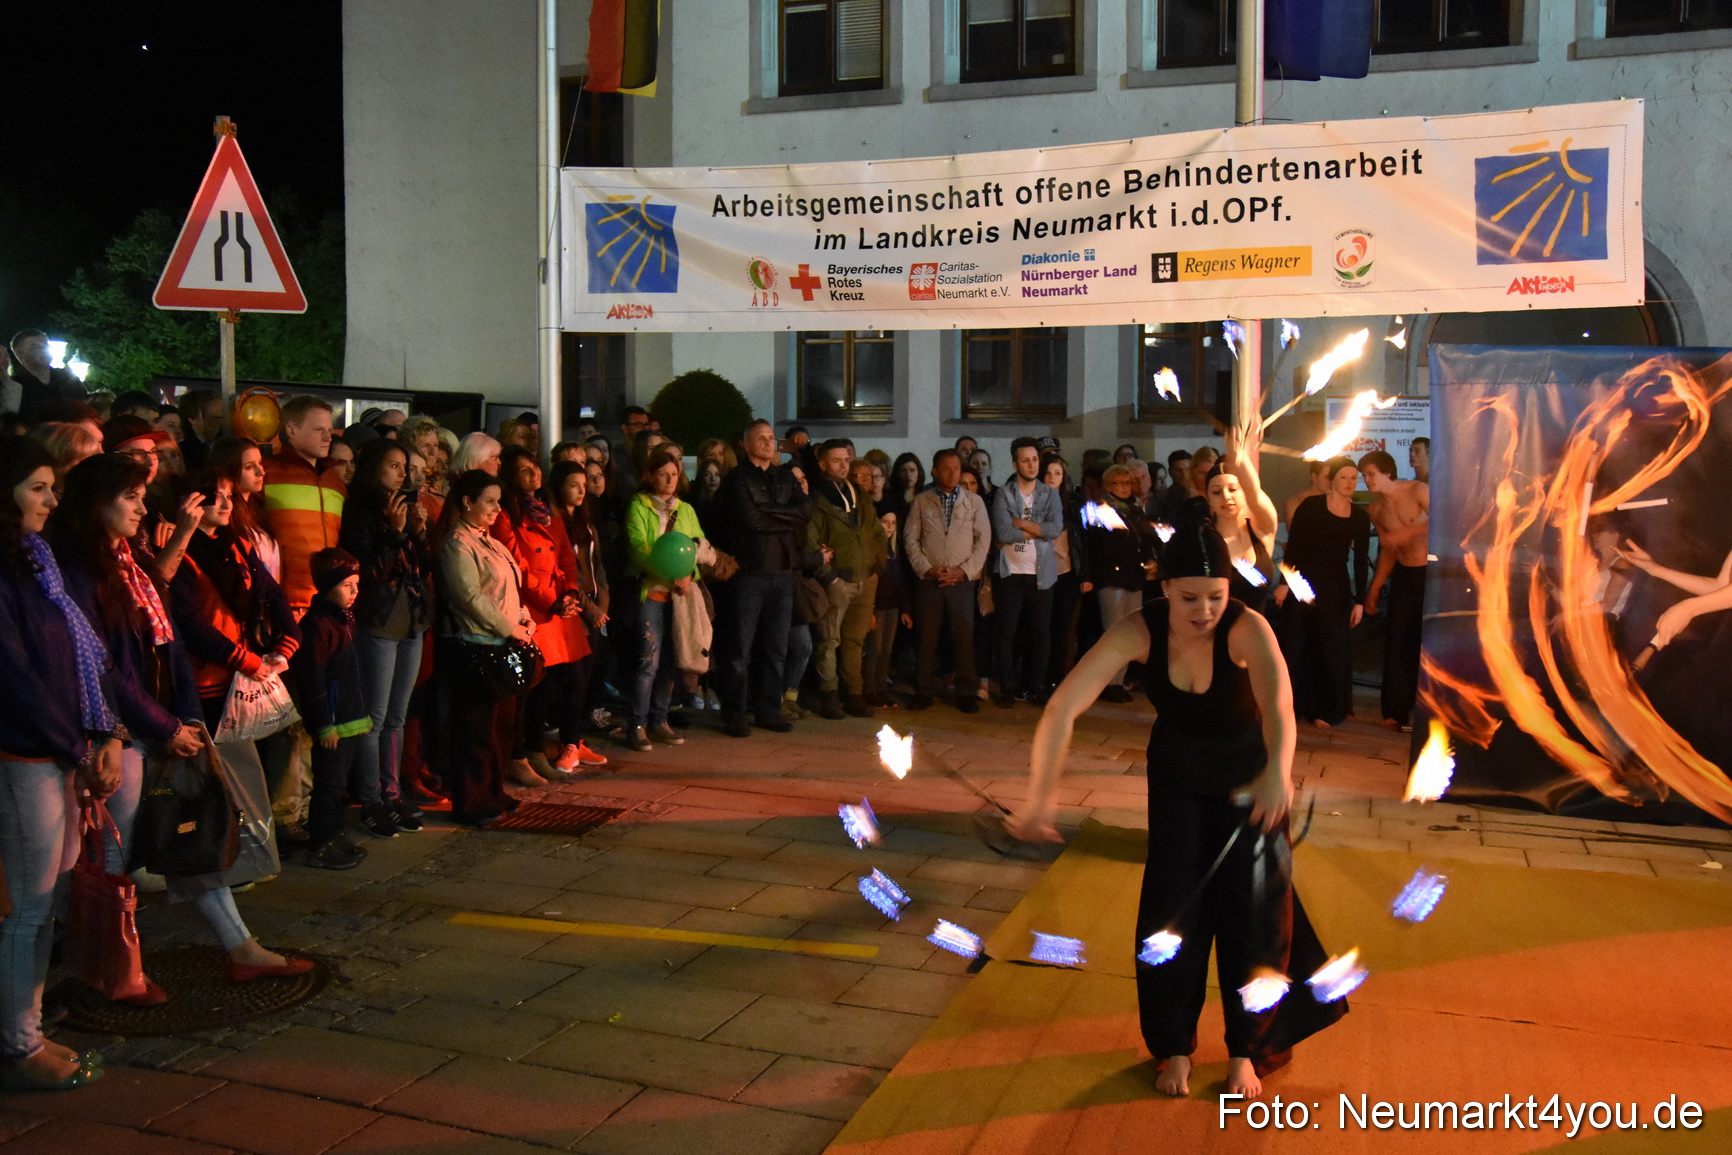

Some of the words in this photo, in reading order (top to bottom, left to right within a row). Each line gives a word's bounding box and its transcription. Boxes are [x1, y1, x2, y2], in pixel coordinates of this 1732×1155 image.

[712, 182, 1004, 222] Arbeitsgemeinschaft
[1015, 177, 1110, 206] offene
[1124, 148, 1423, 195] Behindertenarbeit
[815, 228, 846, 250] im
[858, 221, 1000, 250] Landkreis
[1012, 203, 1158, 241] Neumarkt
[1171, 196, 1292, 228] i.d.OPf.
[1021, 250, 1081, 266] Diakonie
[827, 264, 903, 276] Bayerisches
[939, 262, 980, 272] Caritas-
[1184, 256, 1236, 276] Regens
[1240, 253, 1301, 273] Wagner
[937, 273, 1003, 285] Sozialstation
[1021, 269, 1099, 281] Nürnberger
[1103, 265, 1138, 278] Land
[828, 277, 862, 288] Rotes
[830, 290, 865, 301] Kreuz
[911, 292, 935, 300] caritas
[937, 288, 988, 299] Neumarkt
[990, 287, 1011, 298] e.V.
[1021, 284, 1089, 298] Neumarkt
